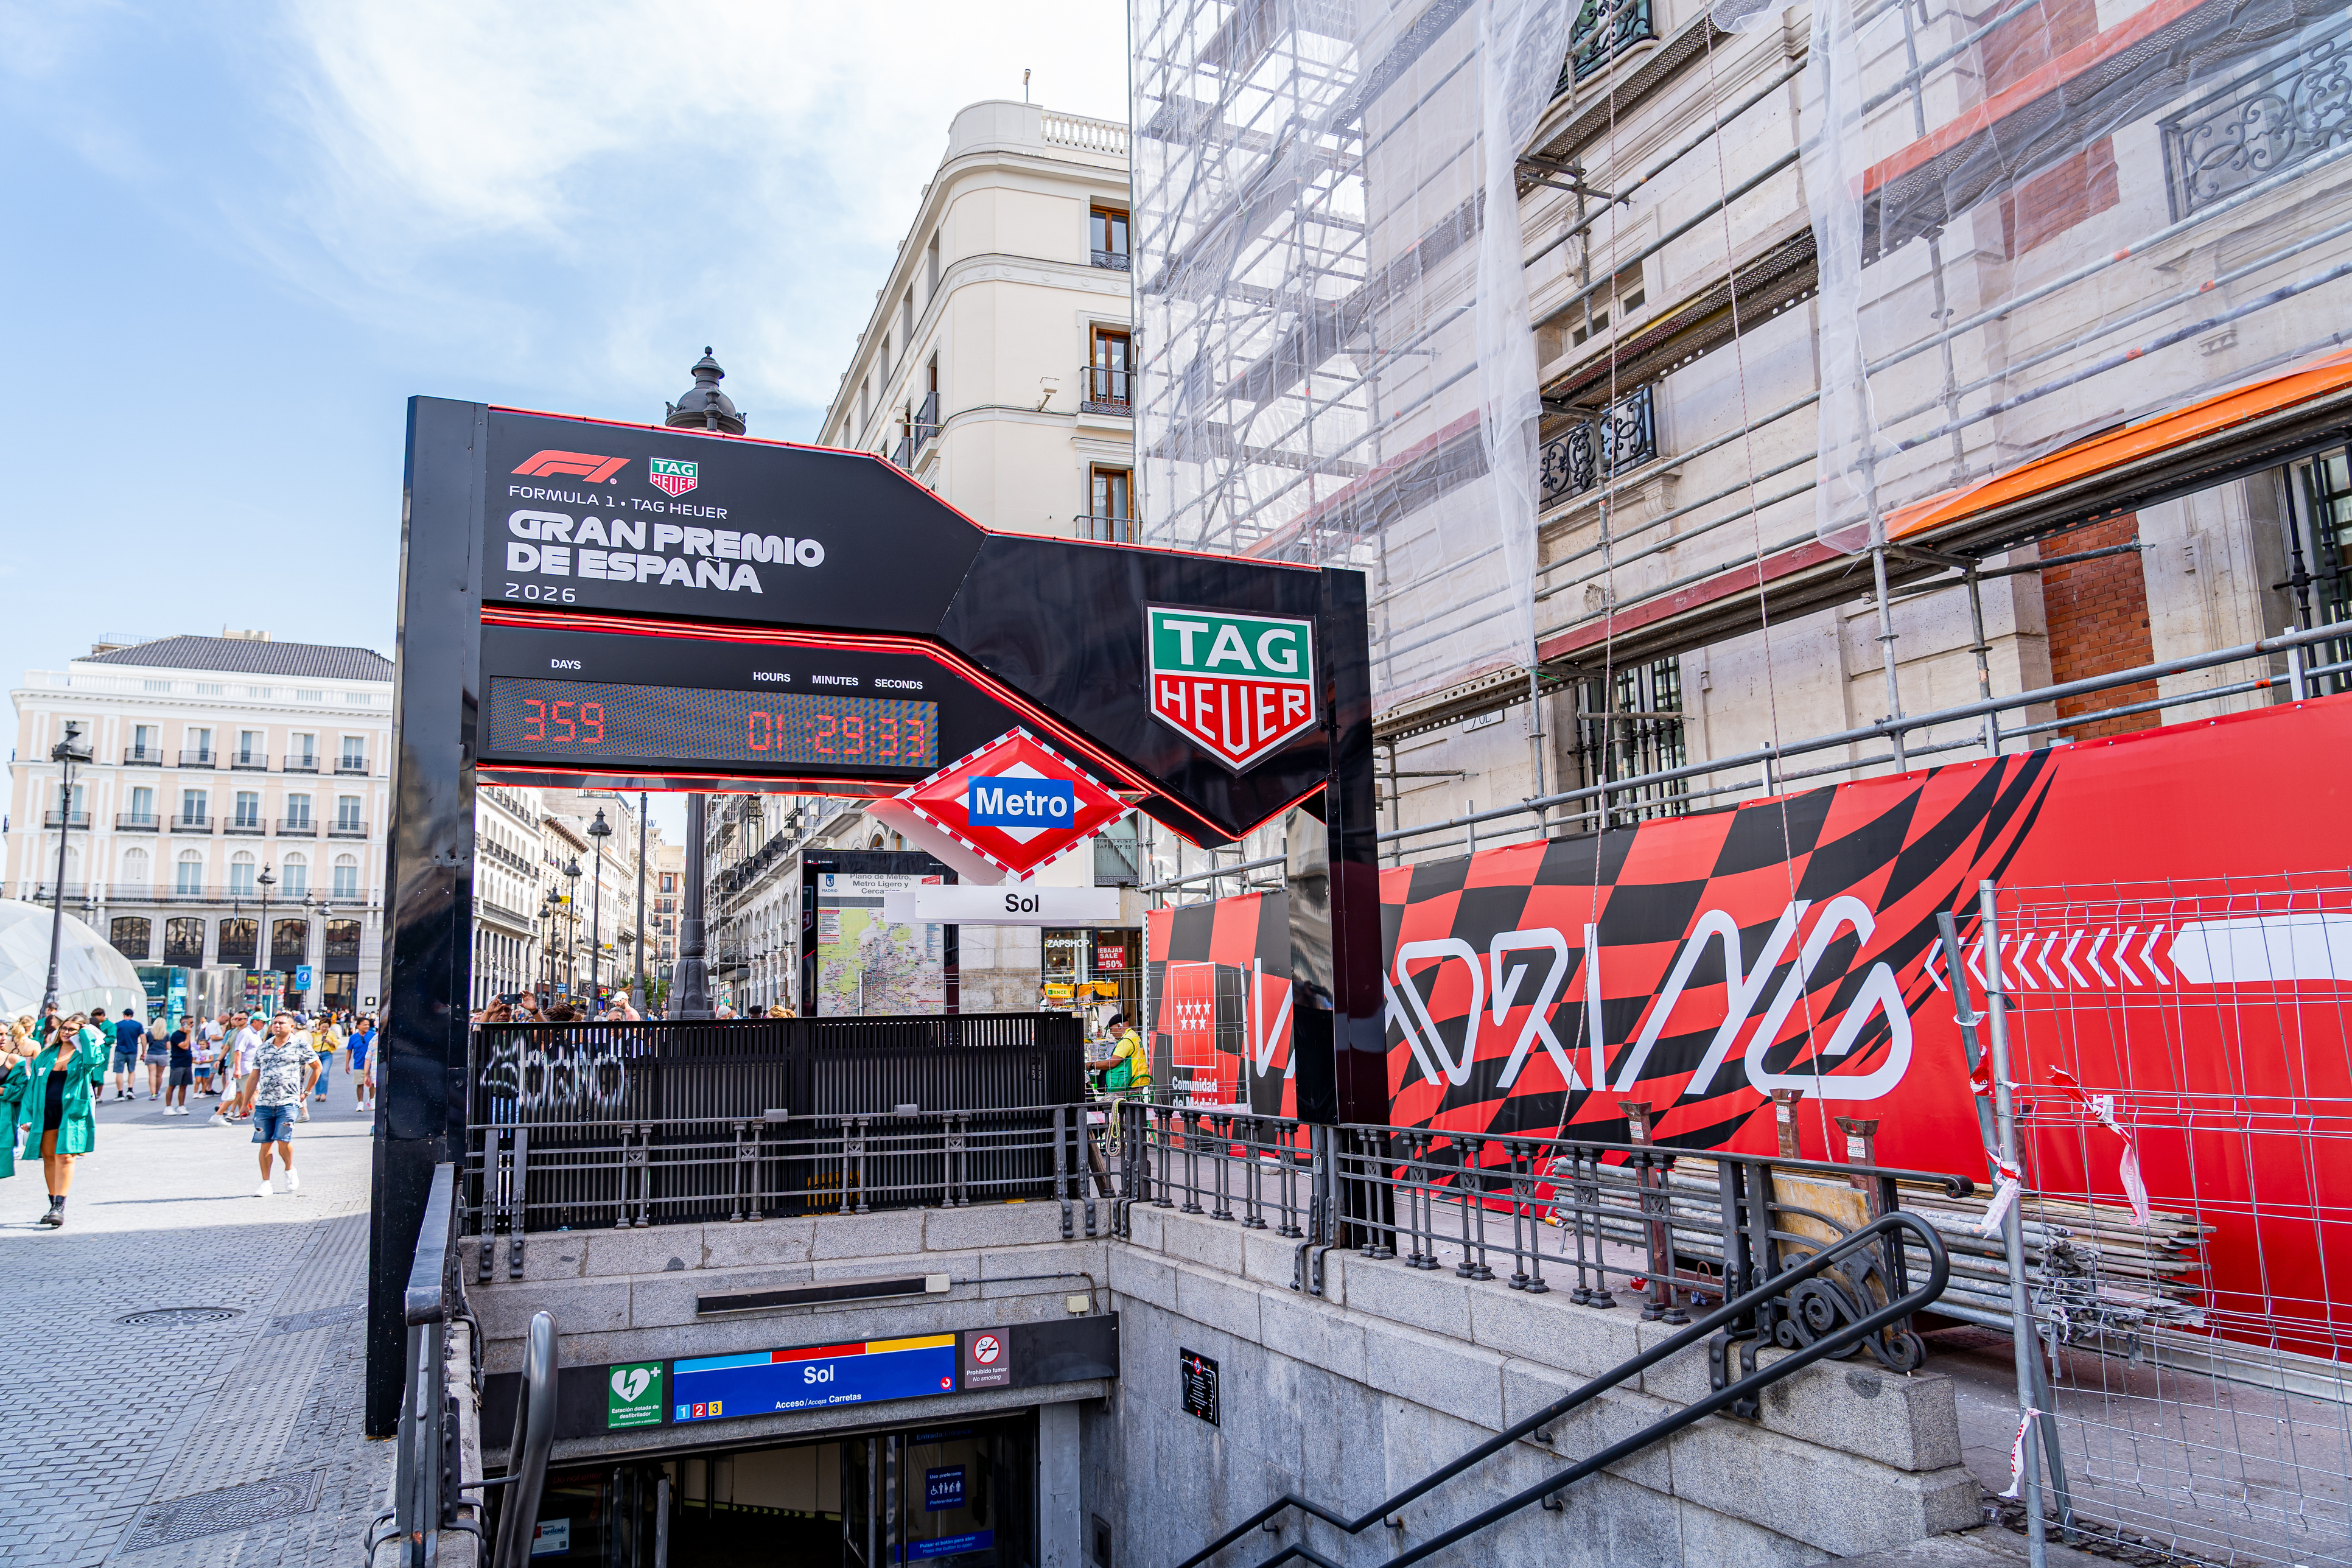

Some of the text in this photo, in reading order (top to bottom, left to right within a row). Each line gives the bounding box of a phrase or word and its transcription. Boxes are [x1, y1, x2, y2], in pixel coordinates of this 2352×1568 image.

[654, 460, 694, 476] TAG
[653, 475, 695, 494] HEUER
[509, 486, 728, 520] FORMULA 1 TAG HEUER
[508, 509, 826, 567] GRAN PREMIO
[506, 542, 763, 594] DE ESPAÑA
[505, 583, 576, 603] 2026
[1163, 619, 1298, 673] TAG
[551, 659, 581, 670] DAYS
[753, 671, 923, 690] HOURS MINUTES SECONDS
[523, 699, 604, 743] 359
[1161, 680, 1306, 756] HEUER
[976, 787, 1067, 817] Metro
[1005, 894, 1040, 912] Sol
[1047, 939, 1090, 948] ZAPSHOP
[1172, 1076, 1217, 1093] Comunidad
[1172, 1096, 1183, 1107] de
[803, 1365, 835, 1385] Sol
[828, 1393, 861, 1403] Carretas
[680, 1403, 719, 1418] 1 2 3
